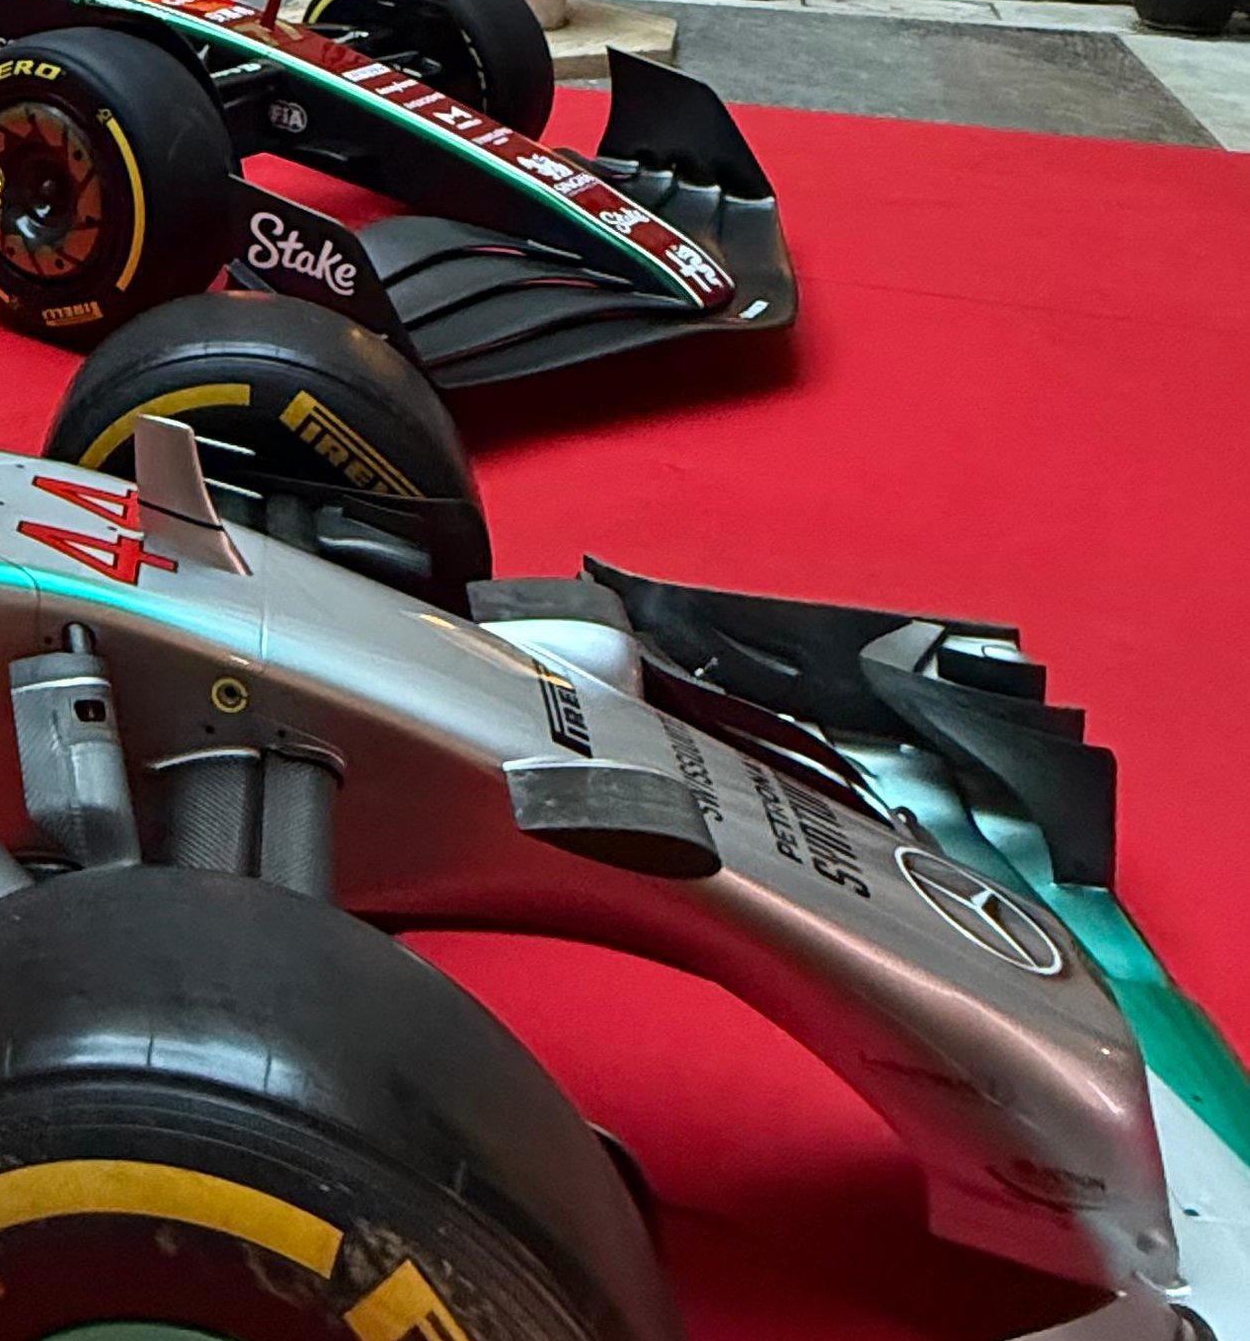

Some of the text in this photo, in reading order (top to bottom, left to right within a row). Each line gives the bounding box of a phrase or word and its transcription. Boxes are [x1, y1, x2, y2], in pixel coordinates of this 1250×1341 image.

[269, 103, 305, 132] FIA
[248, 211, 357, 296] Stake
[16, 475, 179, 586] 44
